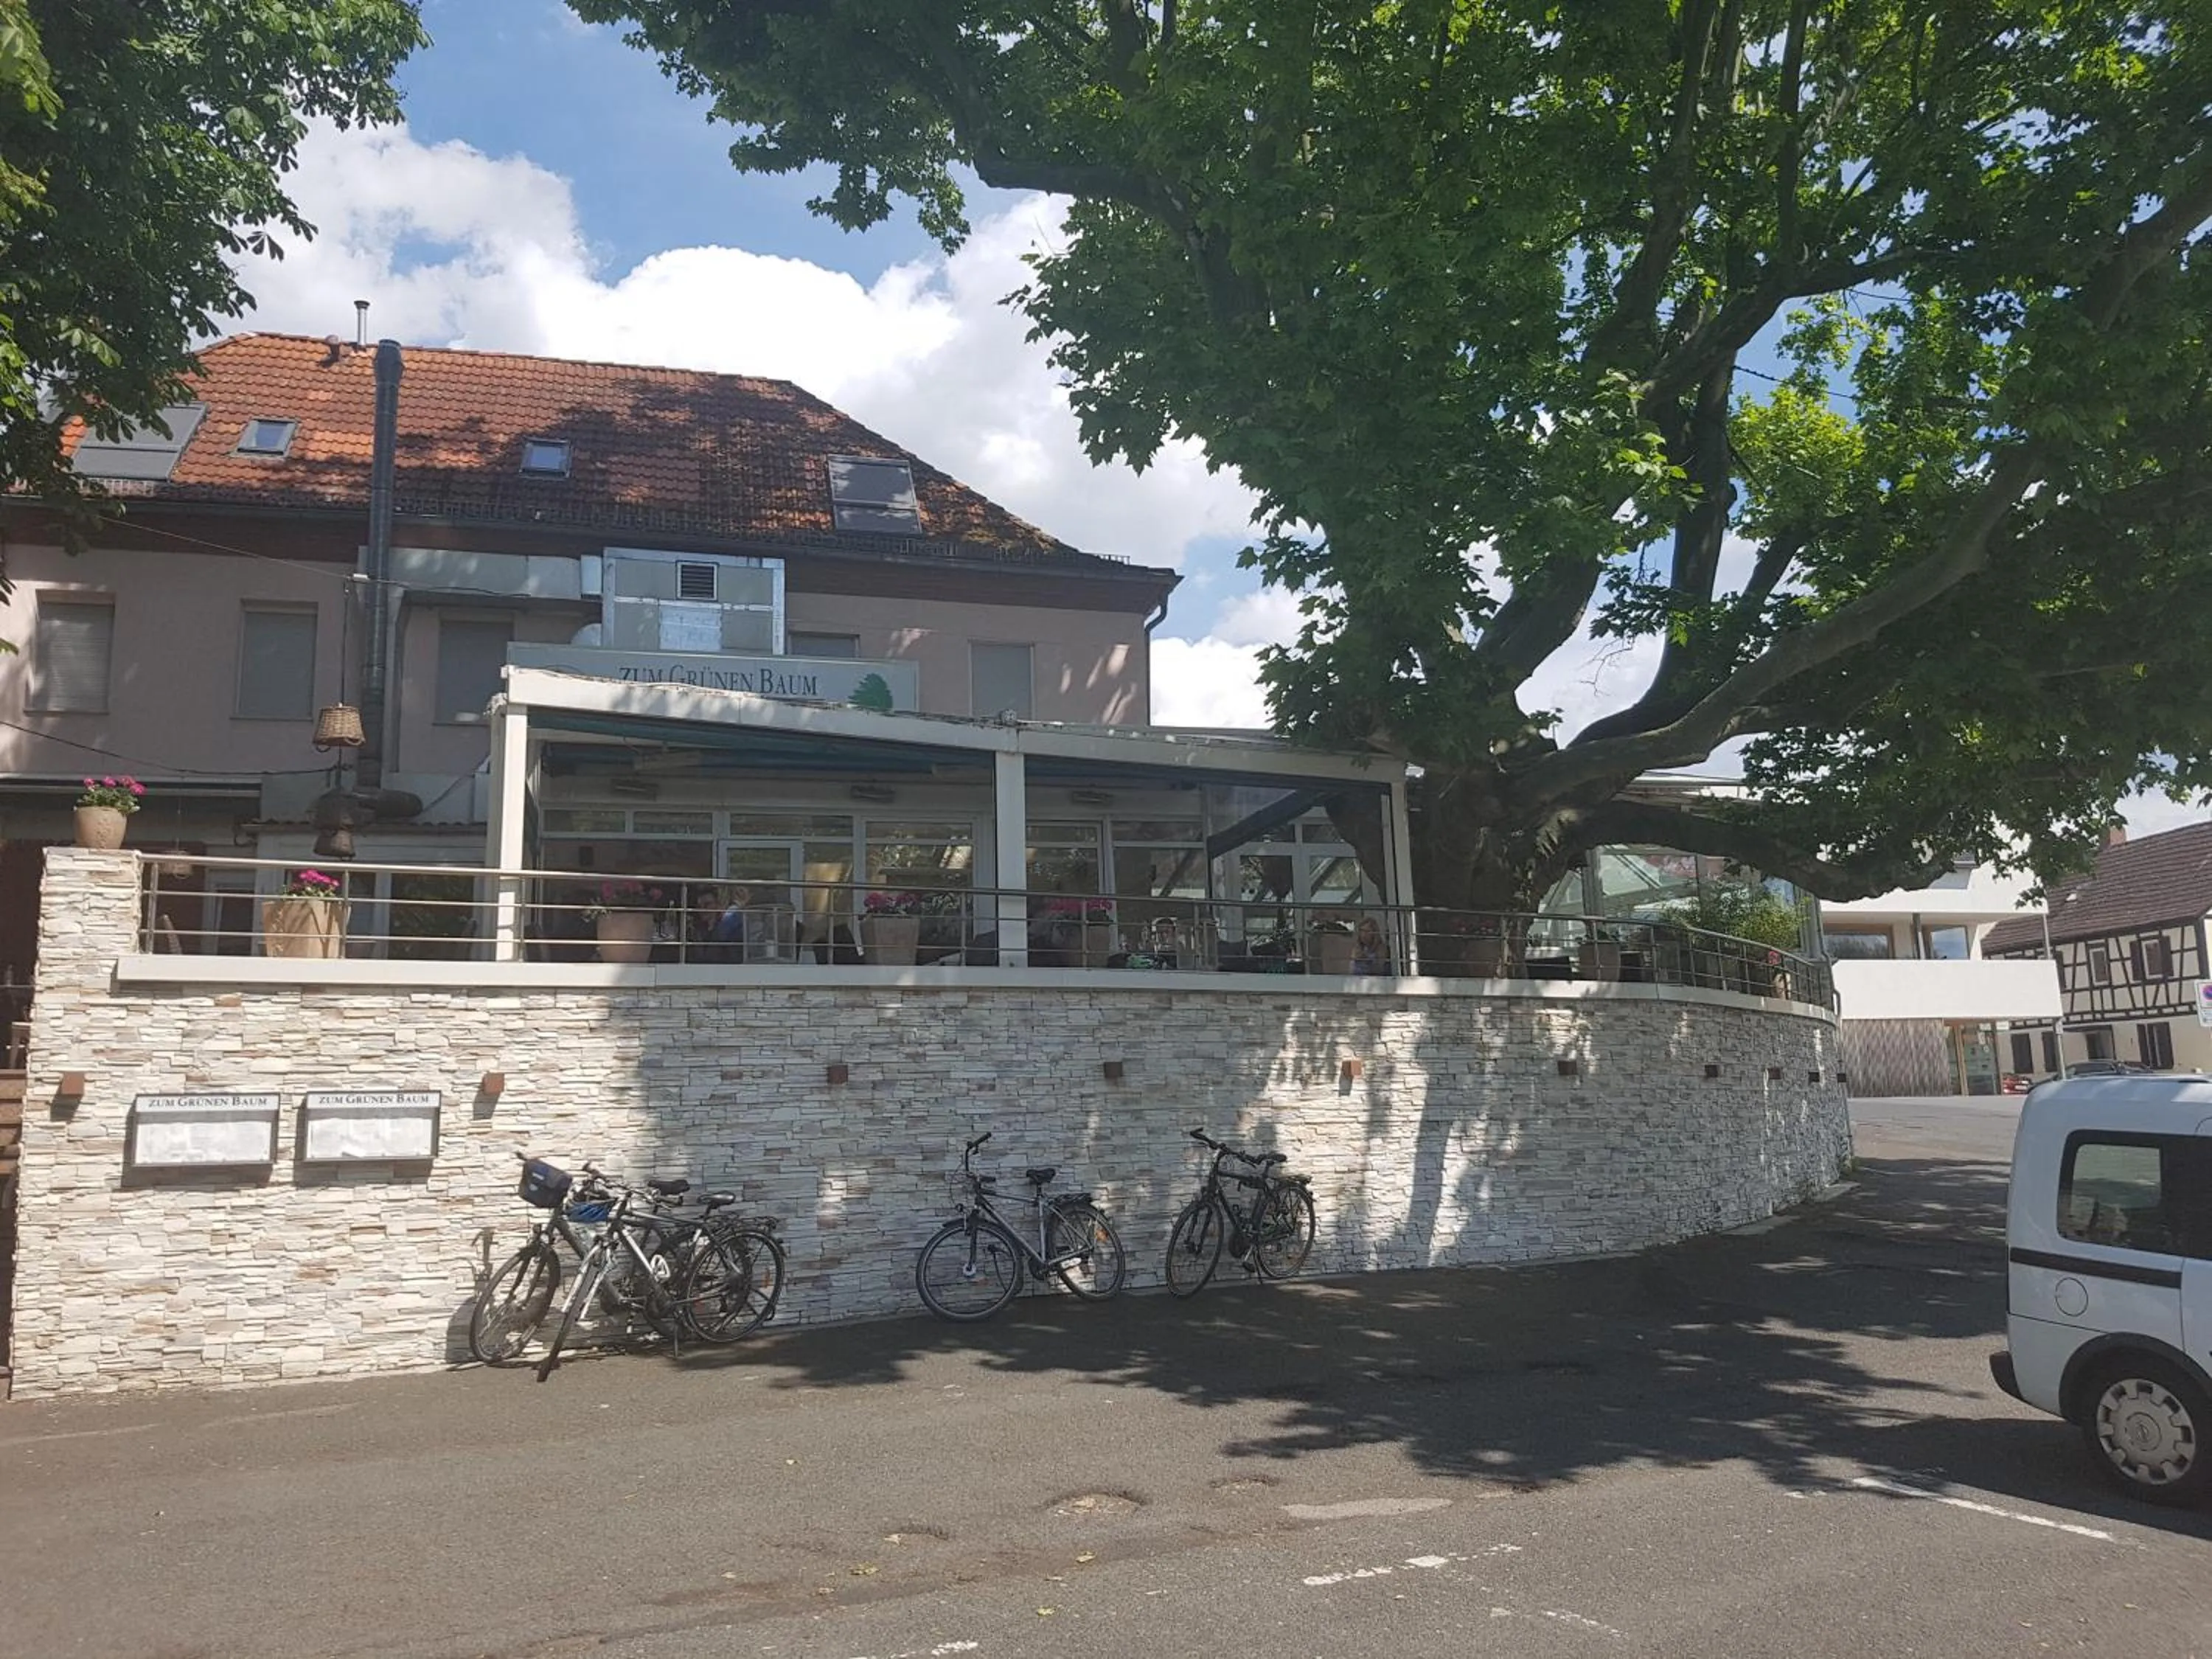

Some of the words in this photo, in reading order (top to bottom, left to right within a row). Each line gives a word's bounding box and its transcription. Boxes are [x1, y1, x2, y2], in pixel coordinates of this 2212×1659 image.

[619, 667, 663, 683] ZUM
[759, 668, 818, 696] BAUM
[147, 1099, 175, 1107] ZUM
[232, 1096, 268, 1106] BAUM
[319, 1096, 344, 1105] ZUM
[396, 1093, 429, 1104] BAUM
